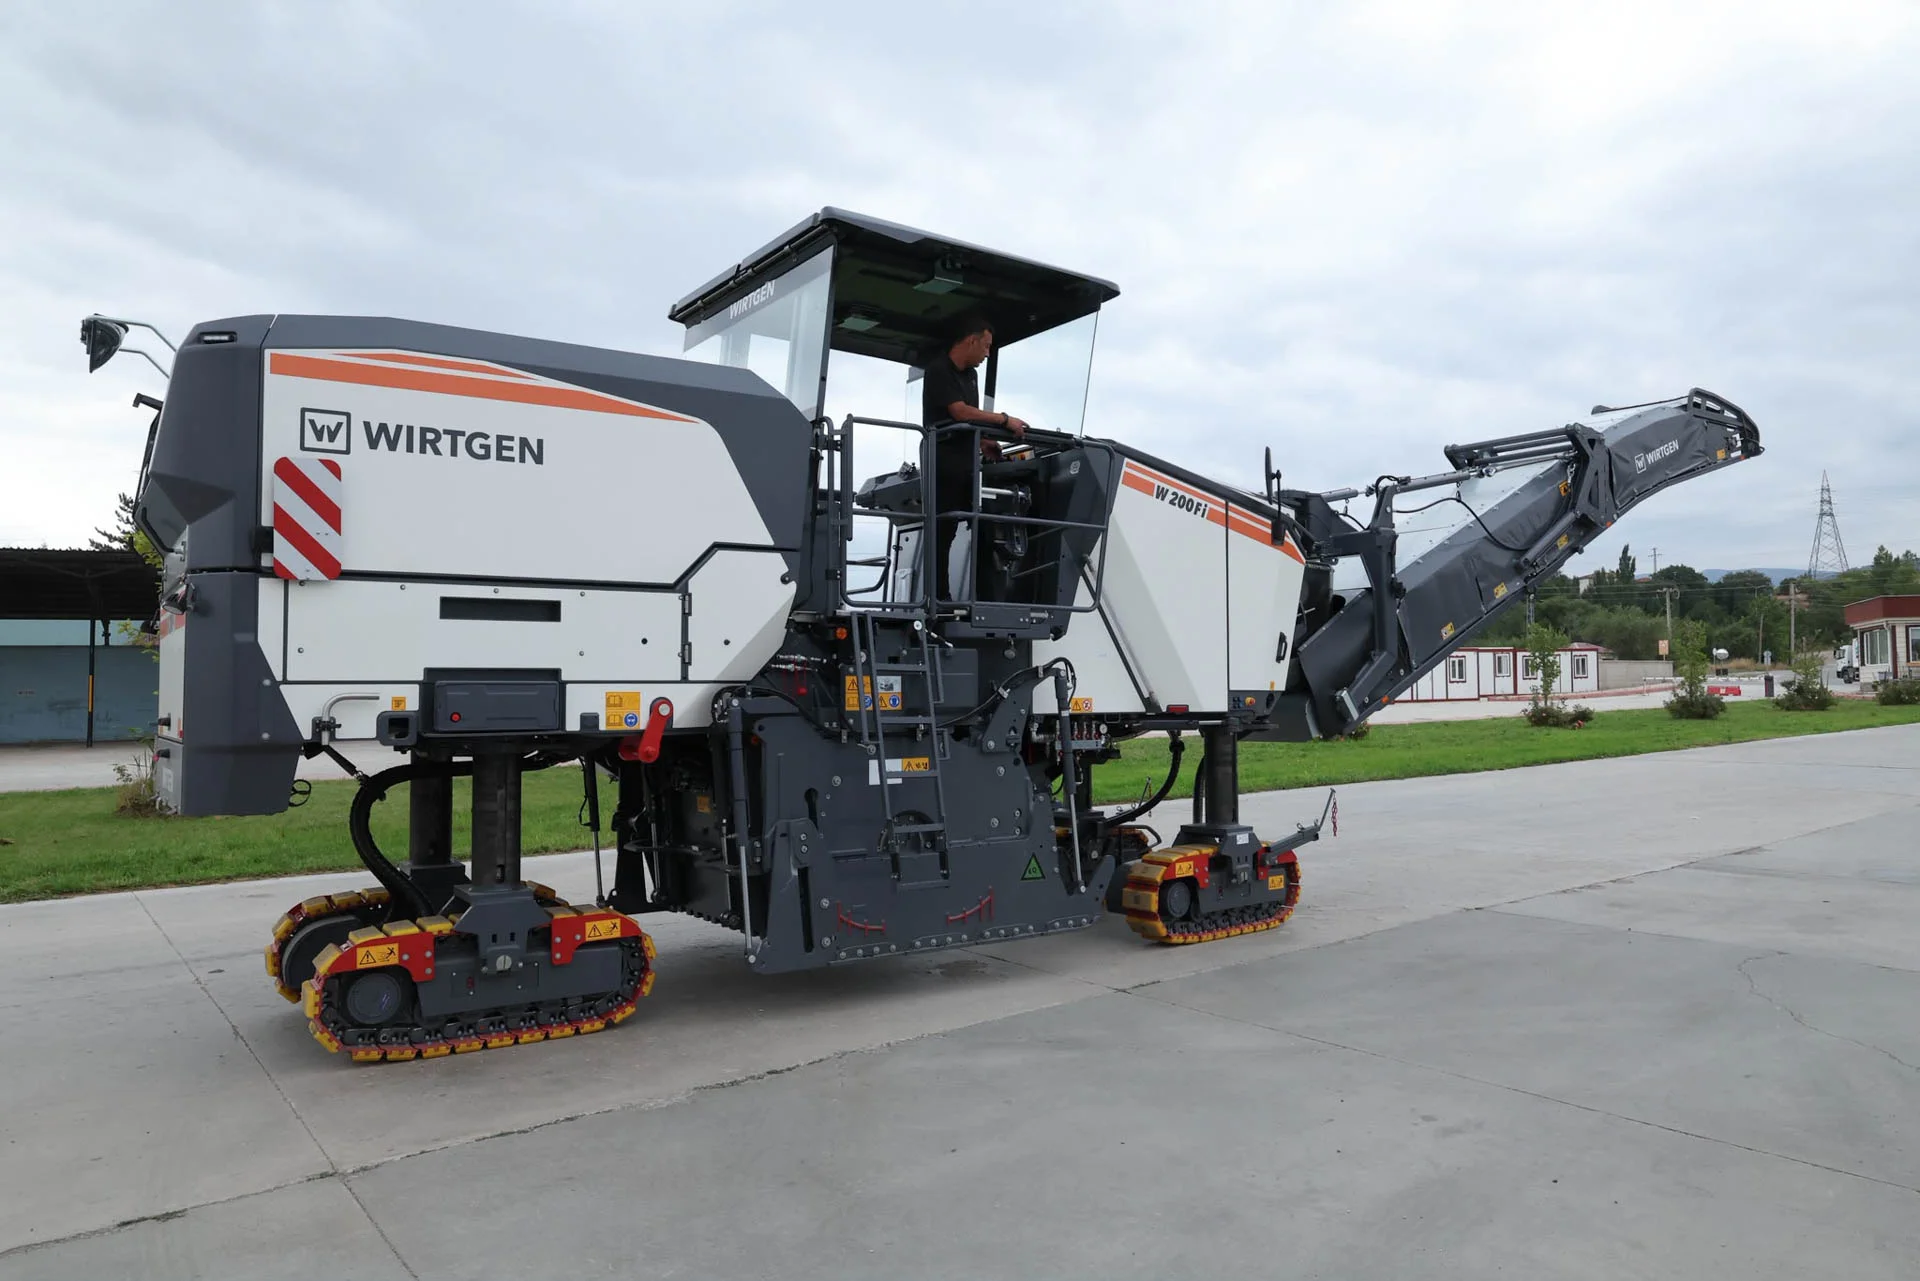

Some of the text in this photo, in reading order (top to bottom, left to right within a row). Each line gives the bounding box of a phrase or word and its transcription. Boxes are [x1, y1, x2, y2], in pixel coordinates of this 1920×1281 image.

[730, 280, 775, 319] WIRTGEN
[308, 418, 544, 465] W WIRTGEN
[1645, 440, 1679, 465] WIRTGEN
[1155, 484, 1208, 518] W 200Fi
